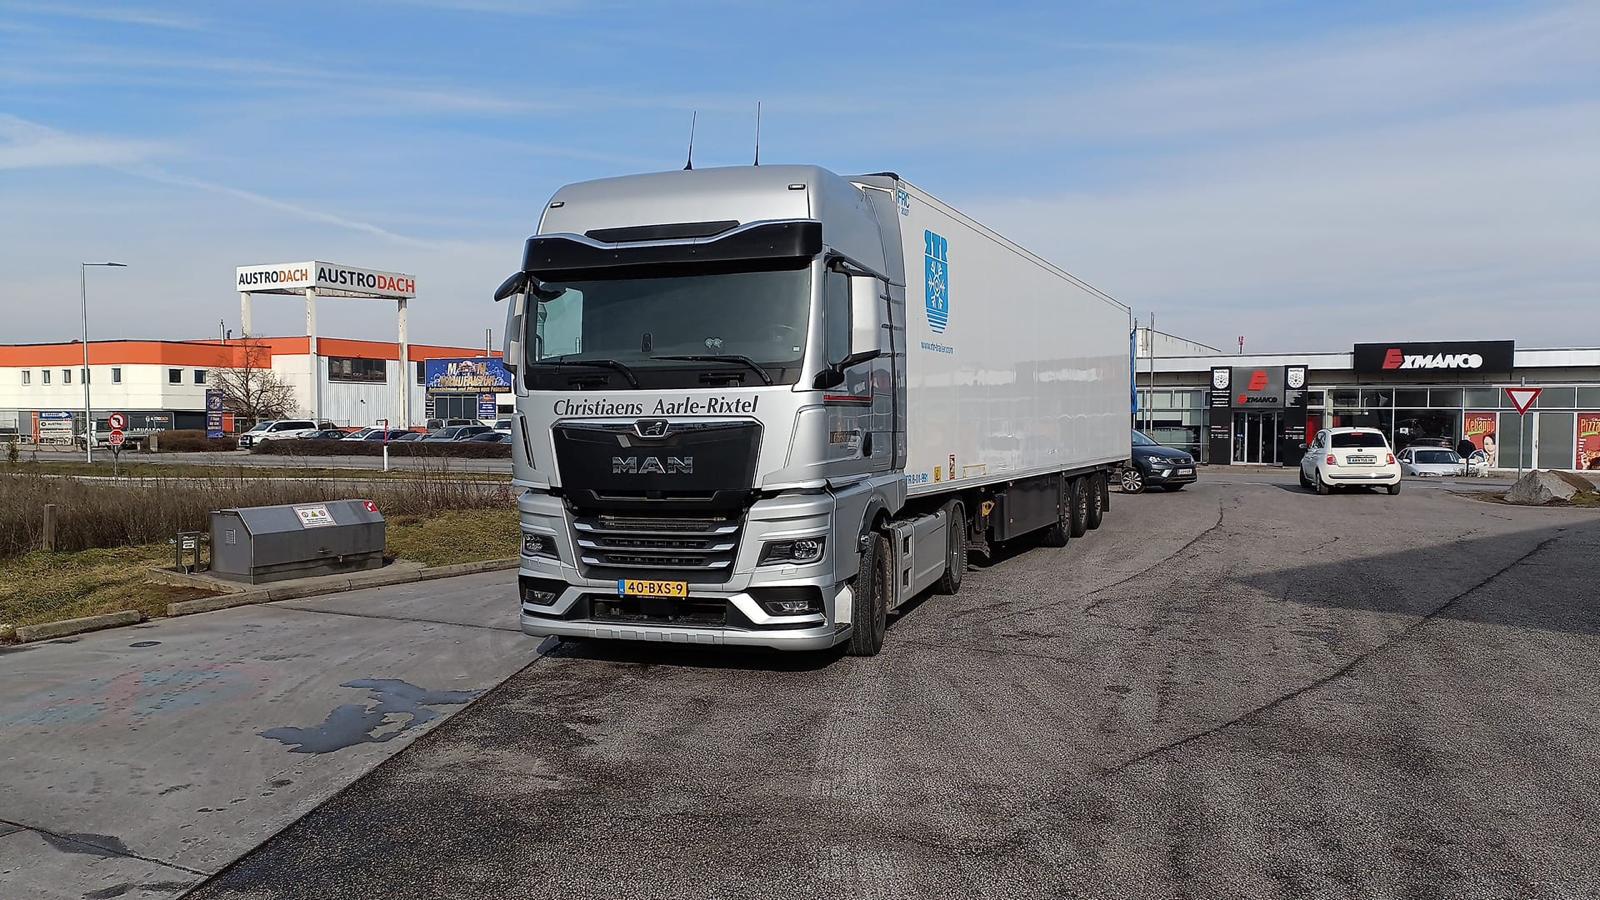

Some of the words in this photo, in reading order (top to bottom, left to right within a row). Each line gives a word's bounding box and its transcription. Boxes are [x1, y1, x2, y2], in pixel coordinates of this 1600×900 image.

[238, 269, 308, 285] AUSTRODACH
[317, 267, 415, 293] AUSTRODACH
[1382, 348, 1483, 369] EXMANCO
[553, 399, 643, 416] Christiaens
[652, 395, 759, 414] Aarle-Rixtel
[612, 457, 693, 474] MAN
[628, 582, 683, 594] 40-BXS-9
